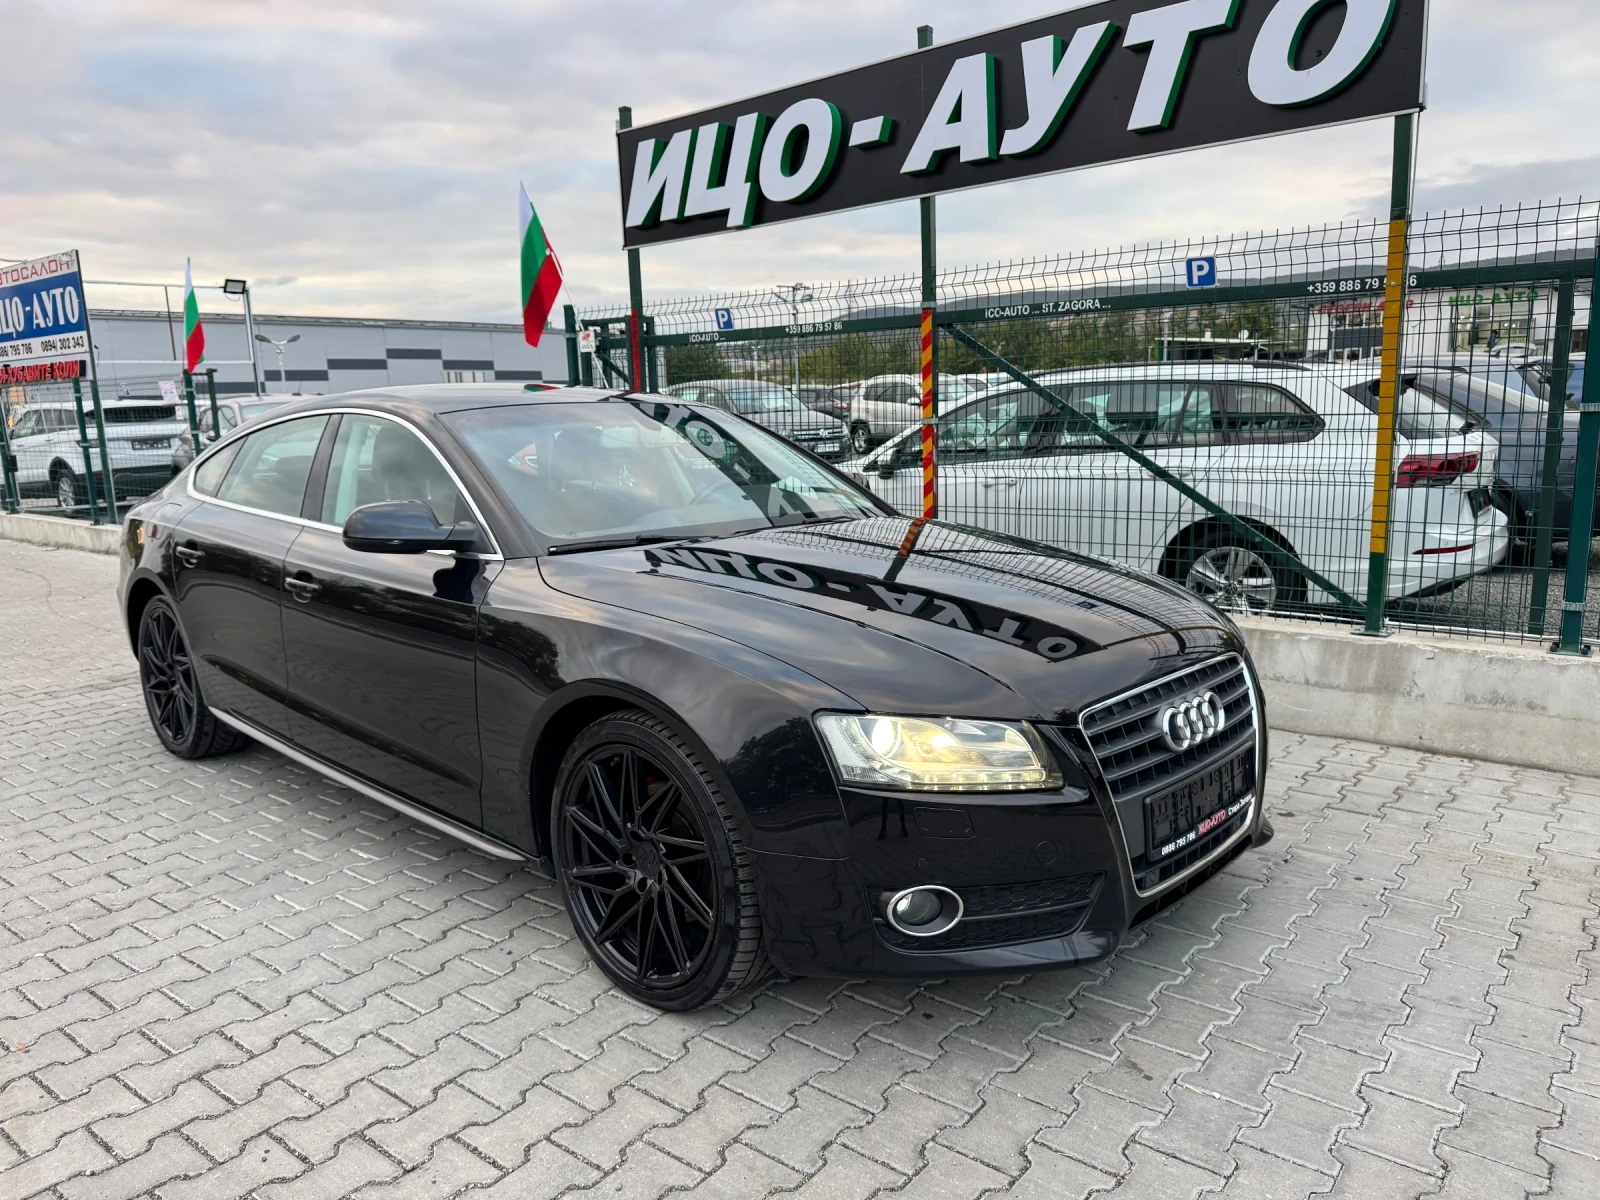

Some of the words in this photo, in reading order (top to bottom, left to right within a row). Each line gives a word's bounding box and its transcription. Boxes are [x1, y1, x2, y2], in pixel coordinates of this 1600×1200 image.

[626, 0, 1395, 228] ИЦО-АУТО
[1191, 260, 1210, 284] P
[1307, 281, 1336, 293] +359
[1339, 279, 1361, 292] 886
[1364, 278, 1379, 290] 79
[0, 286, 79, 339] ЦО-АУТО
[1042, 302, 1056, 313] ST.
[1058, 299, 1101, 311] ZAGORA
[718, 310, 729, 328] P
